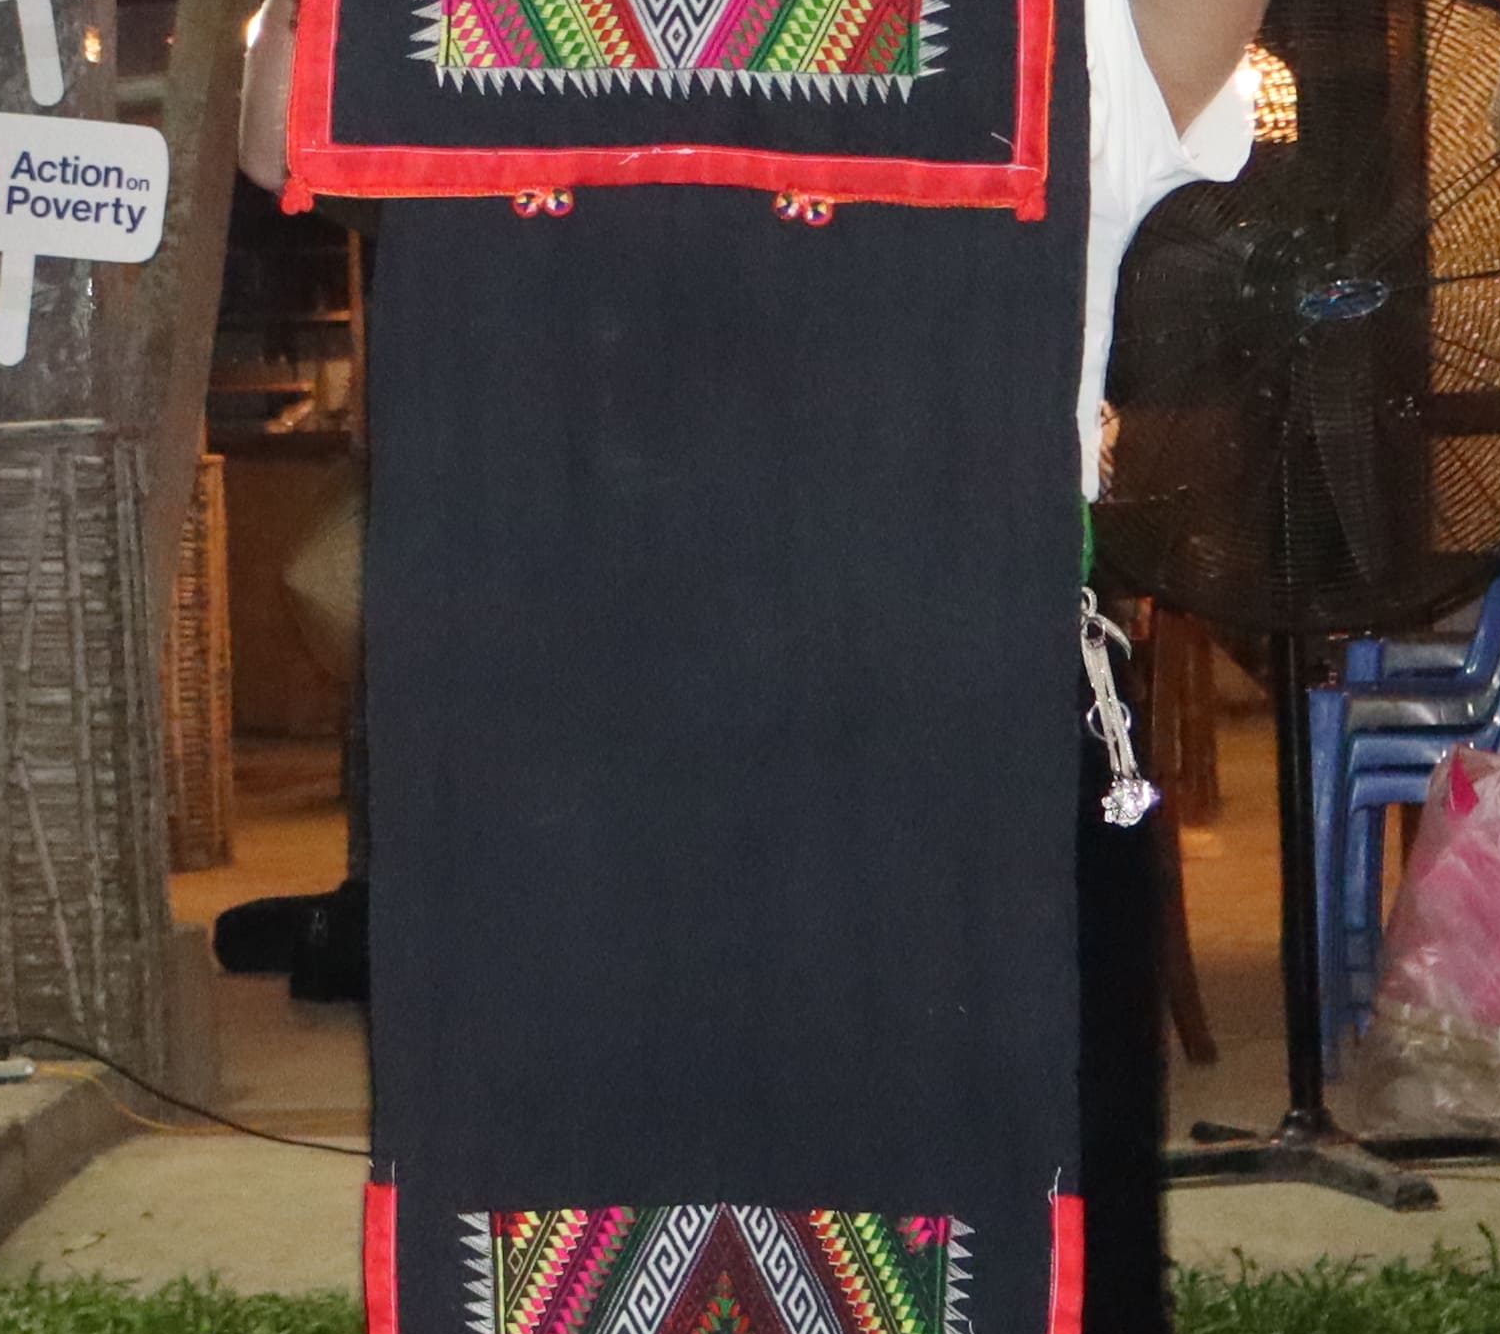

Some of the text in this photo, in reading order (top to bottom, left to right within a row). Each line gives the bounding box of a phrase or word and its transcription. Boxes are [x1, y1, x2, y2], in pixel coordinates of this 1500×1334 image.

[10, 150, 150, 192] Action on
[5, 185, 147, 234] Poverty
